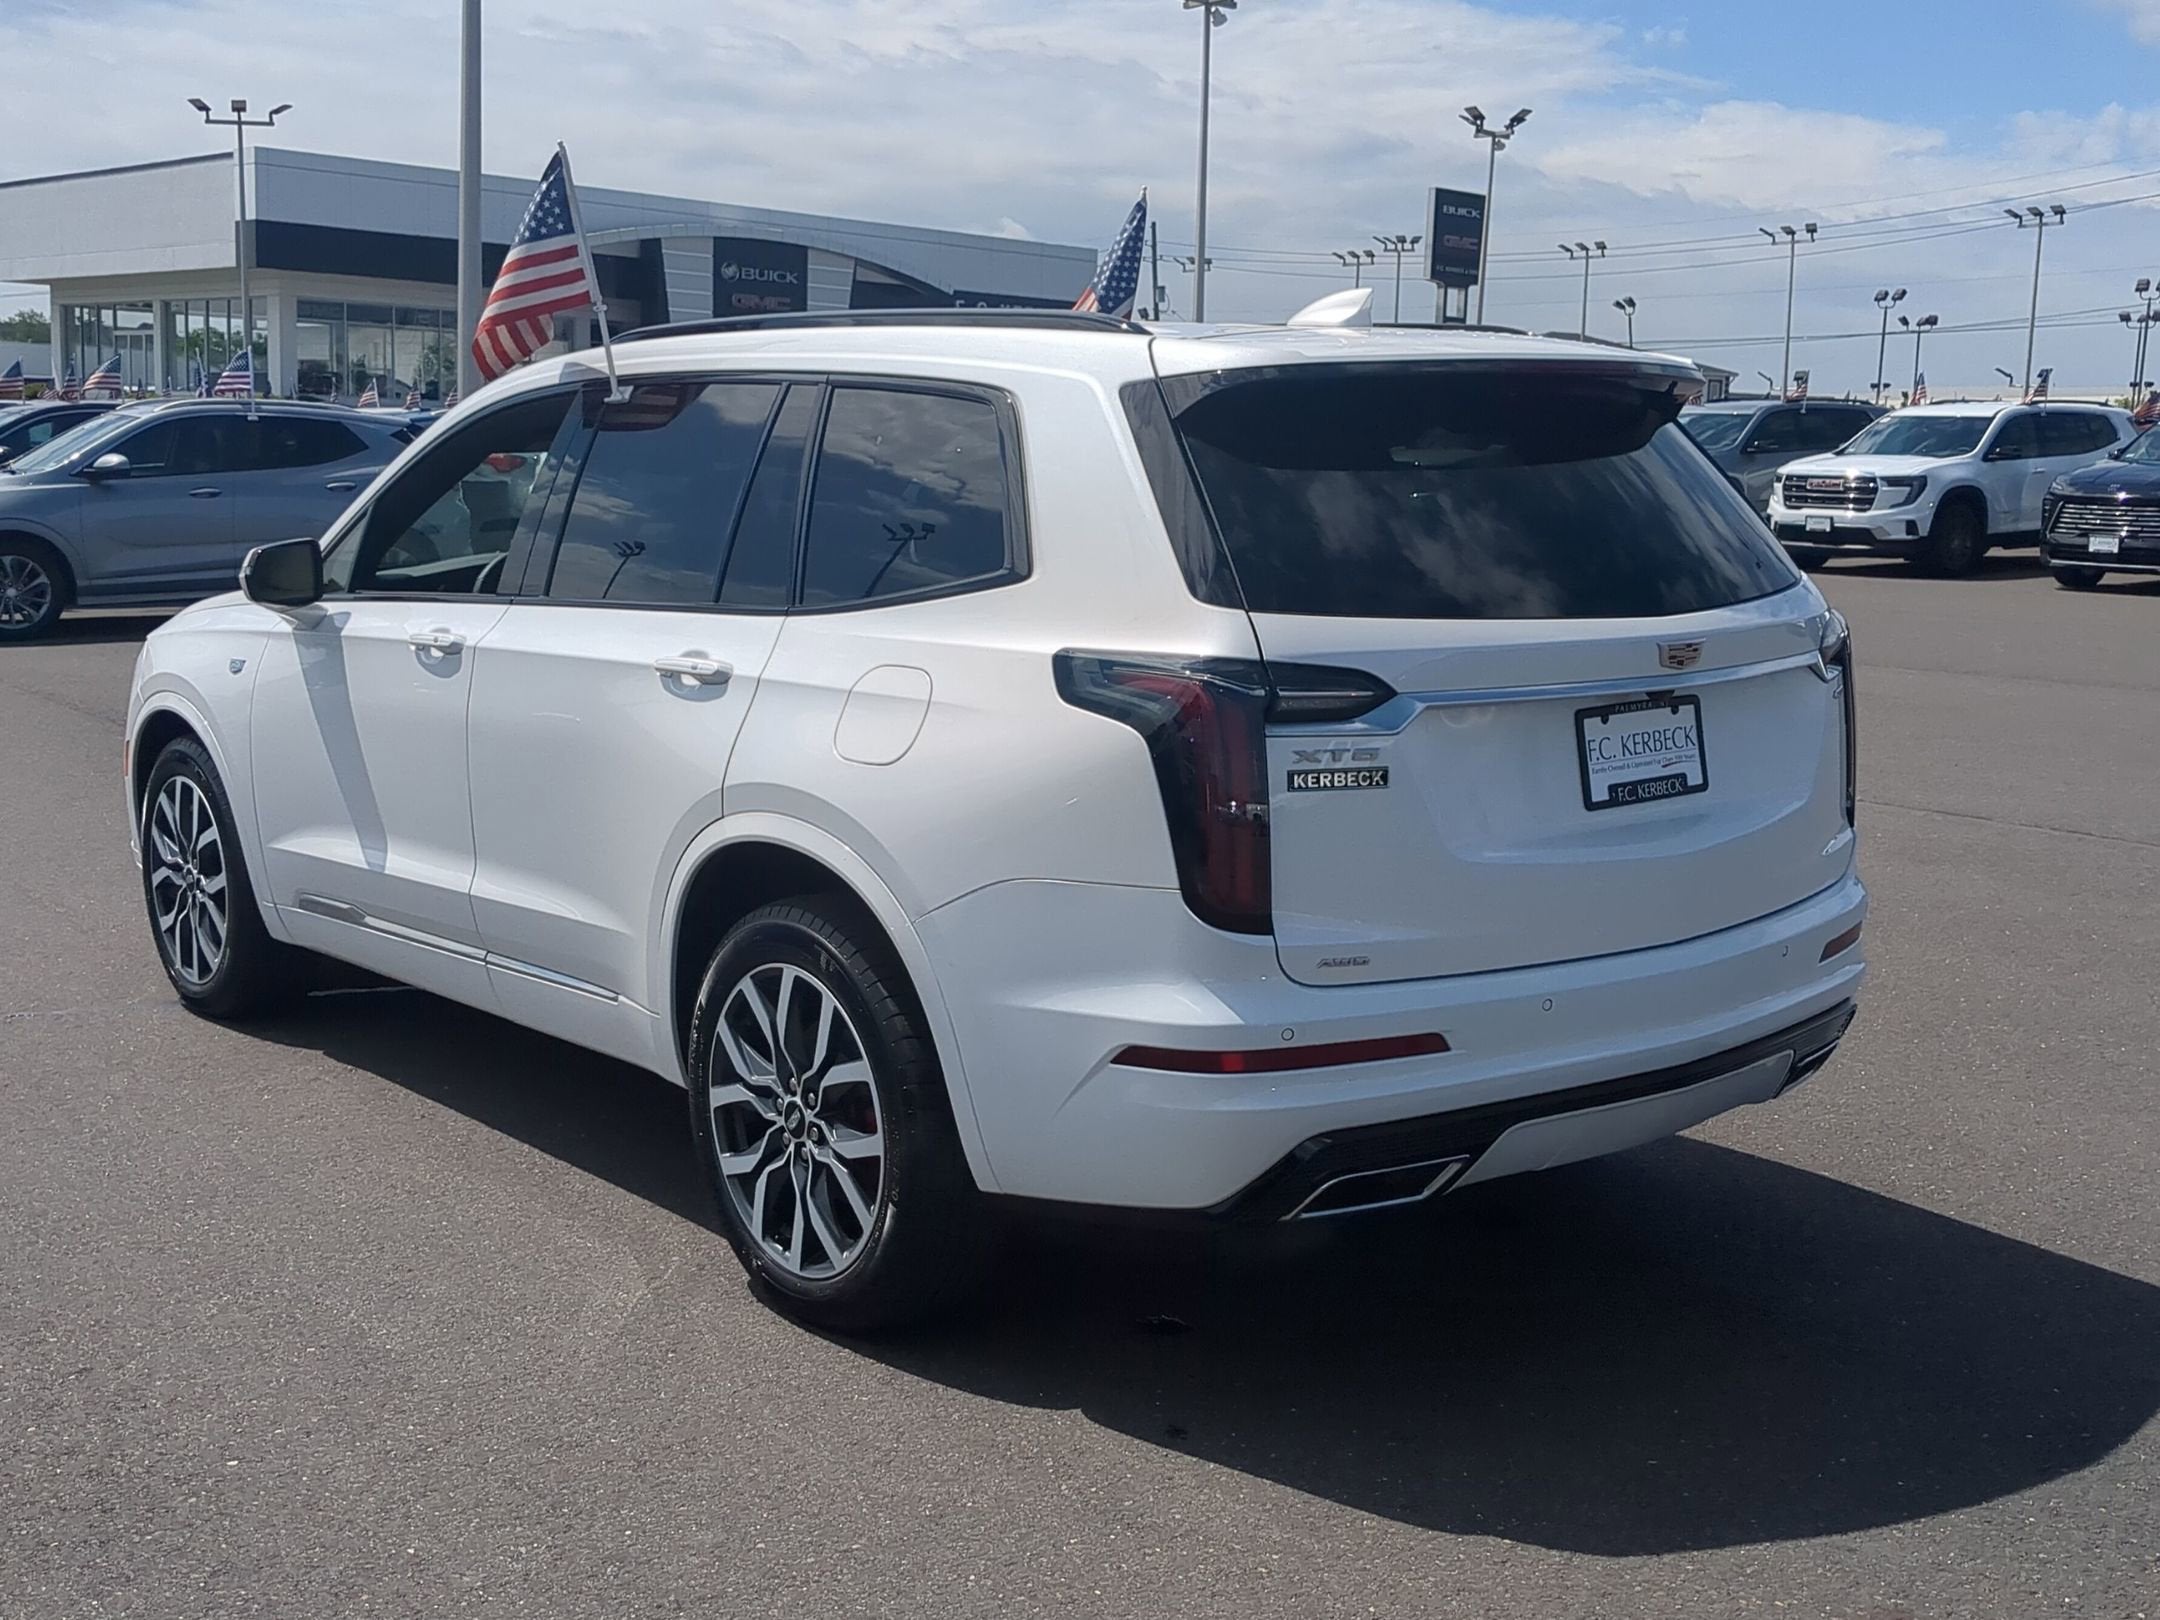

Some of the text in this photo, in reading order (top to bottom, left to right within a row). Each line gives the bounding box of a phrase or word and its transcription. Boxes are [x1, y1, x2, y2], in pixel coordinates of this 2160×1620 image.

[1443, 205, 1480, 219] BUICK
[1443, 235, 1478, 250] GMC
[742, 267, 798, 284] BUICK
[732, 293, 791, 310] GMC
[1588, 725, 1696, 762] F.C. KERBECK
[1292, 748, 1380, 764] XT6
[1293, 772, 1384, 788] KERBECK
[1618, 778, 1683, 801] F.C. KERBECK
